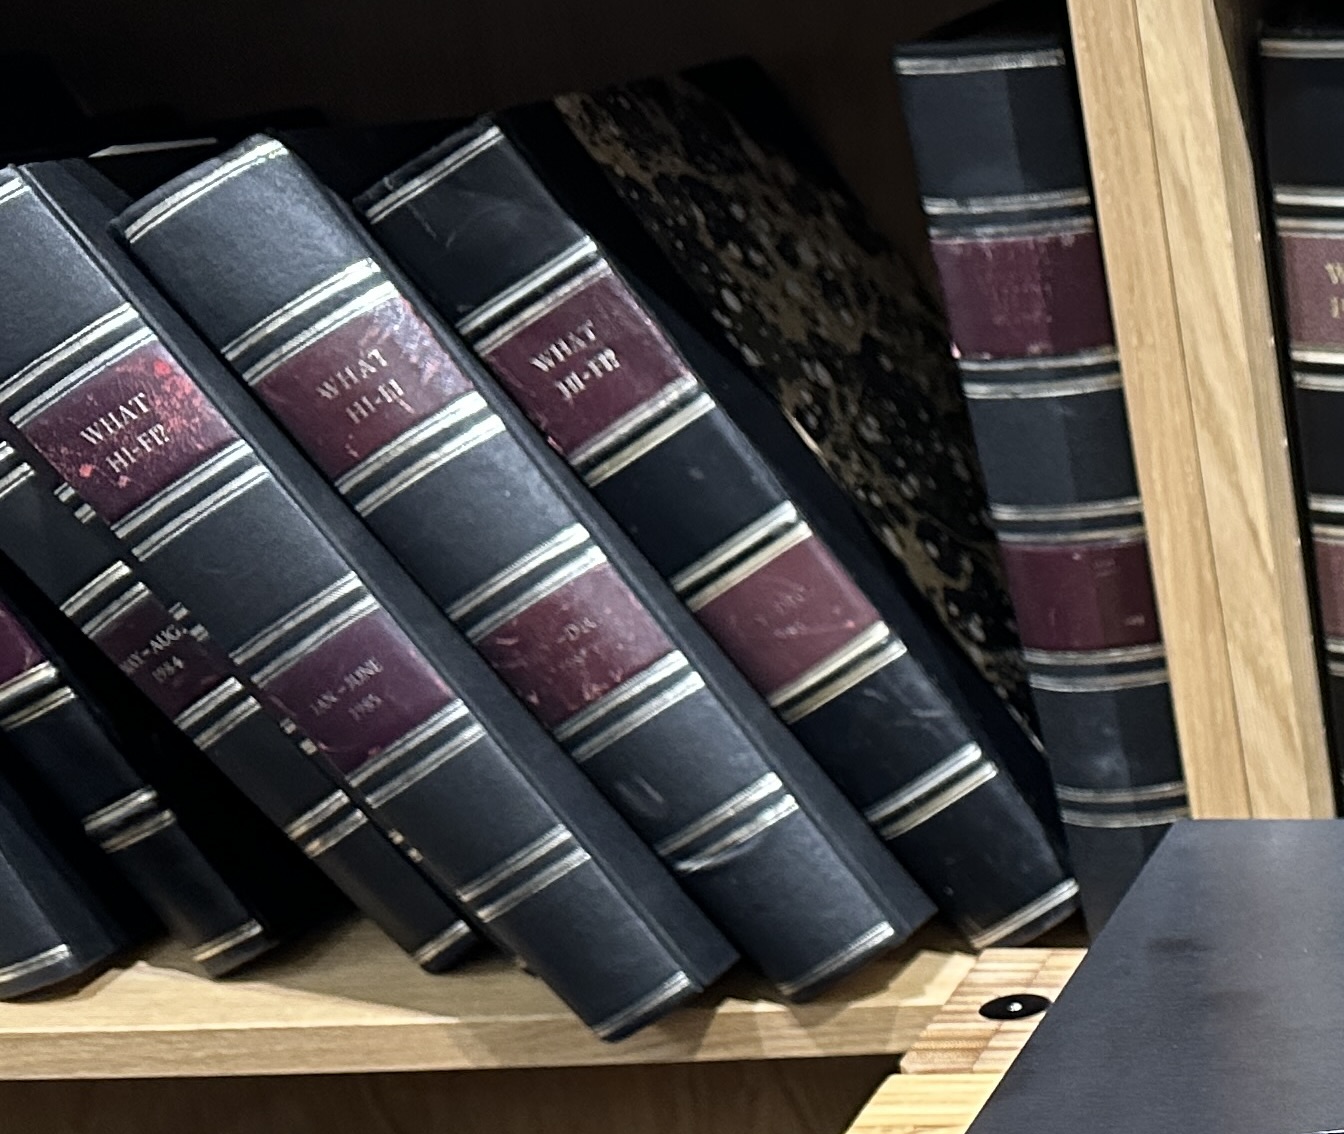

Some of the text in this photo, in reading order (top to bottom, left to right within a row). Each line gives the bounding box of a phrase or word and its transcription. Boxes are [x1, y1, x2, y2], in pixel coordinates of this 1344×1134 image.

[530, 319, 597, 372] WHAT
[315, 348, 388, 400] WHAT
[80, 392, 150, 445] WHAT
[105, 423, 170, 474] HI-FI?
